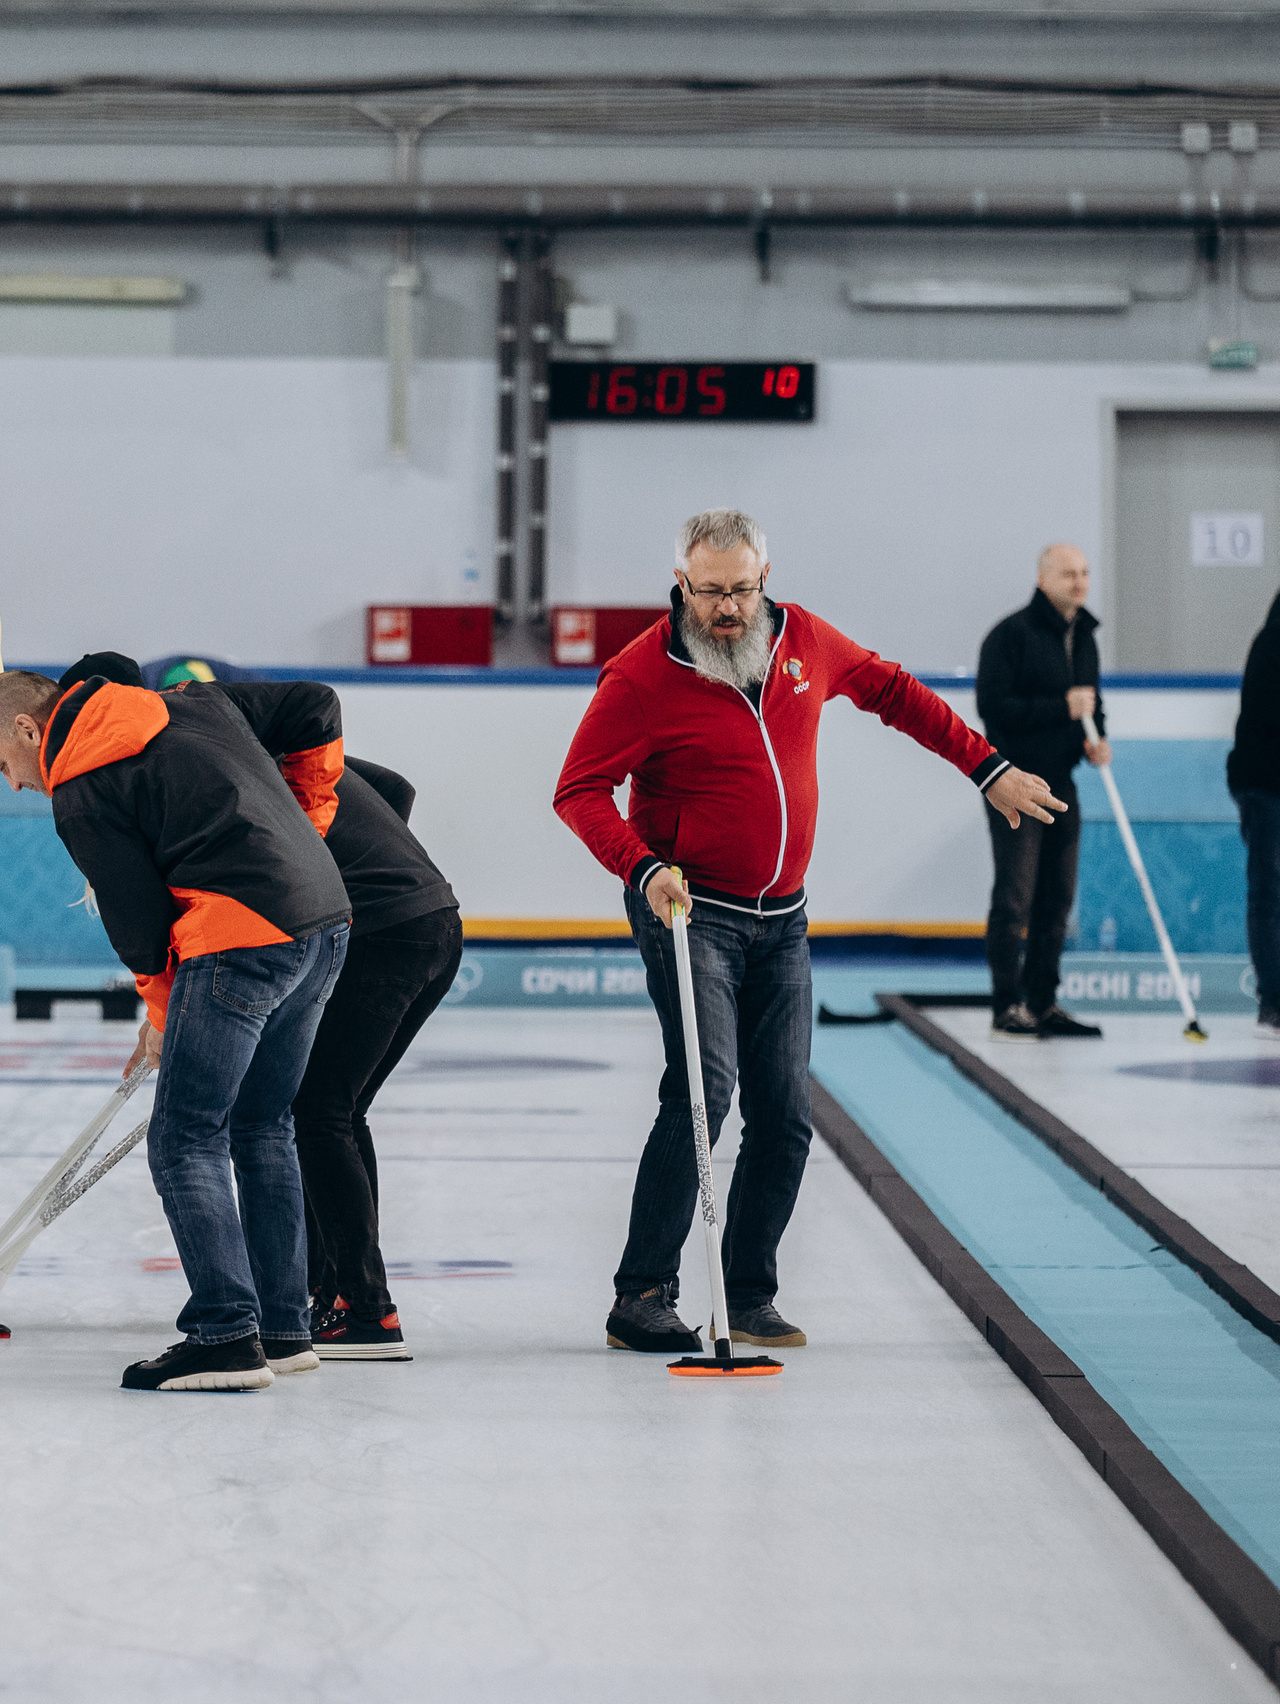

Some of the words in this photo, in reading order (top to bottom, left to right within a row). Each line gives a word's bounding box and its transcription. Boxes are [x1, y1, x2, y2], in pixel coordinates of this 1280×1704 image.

[587, 366, 726, 415] 16:05
[762, 366, 800, 398] 10
[1204, 520, 1251, 559] 10
